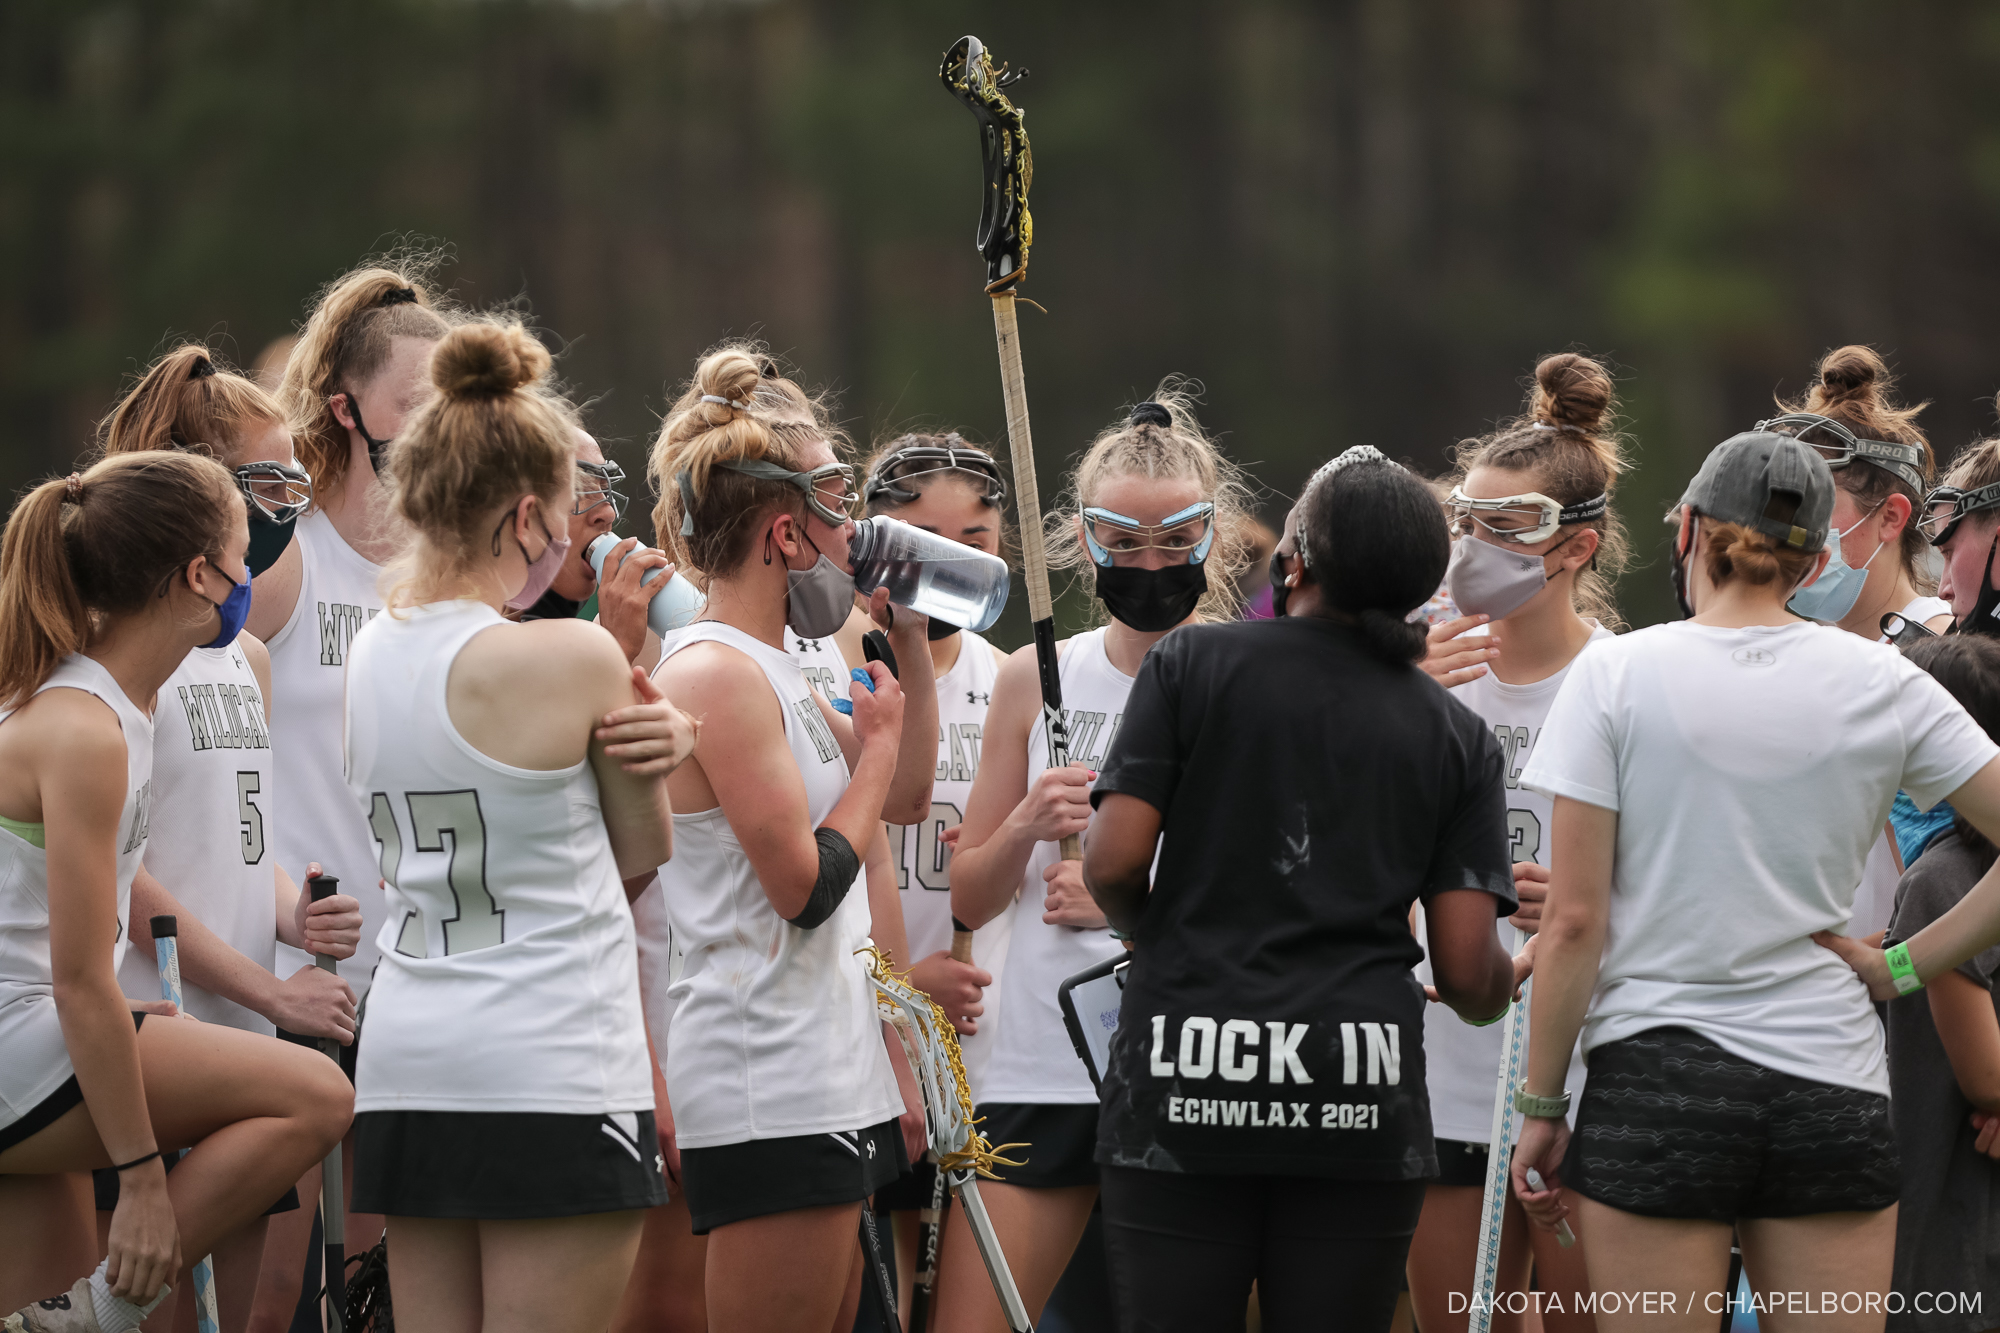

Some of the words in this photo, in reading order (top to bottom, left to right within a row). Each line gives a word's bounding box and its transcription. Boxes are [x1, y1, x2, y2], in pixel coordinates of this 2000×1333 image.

[1868, 443, 1903, 458] PRO
[237, 771, 265, 865] 5
[1150, 1015, 1314, 1085] LOCK
[1340, 1022, 1400, 1086] IN
[1168, 1097, 1310, 1128] ECHWLAX
[1321, 1103, 1379, 1129] 2021
